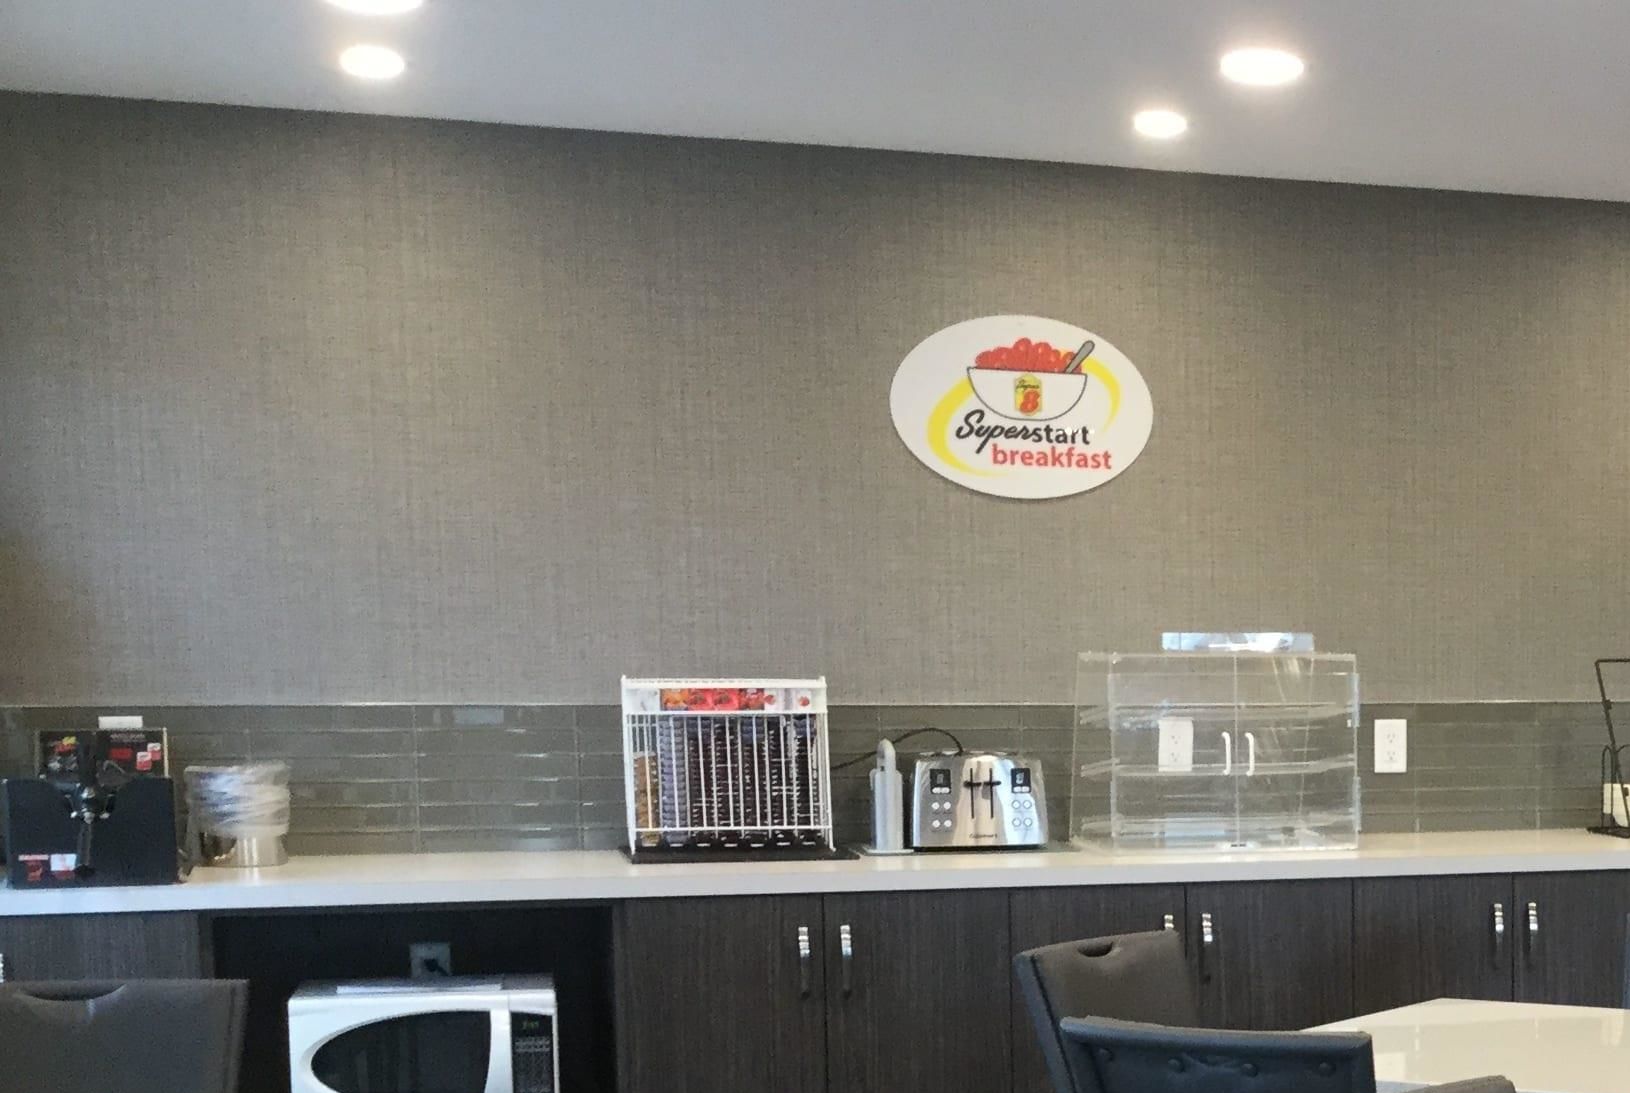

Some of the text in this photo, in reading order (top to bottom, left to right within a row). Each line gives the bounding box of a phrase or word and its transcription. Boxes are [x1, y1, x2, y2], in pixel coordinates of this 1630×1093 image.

[1019, 390, 1041, 414] 8
[955, 409, 1091, 455] Superstart
[991, 443, 1113, 470] breakfast
